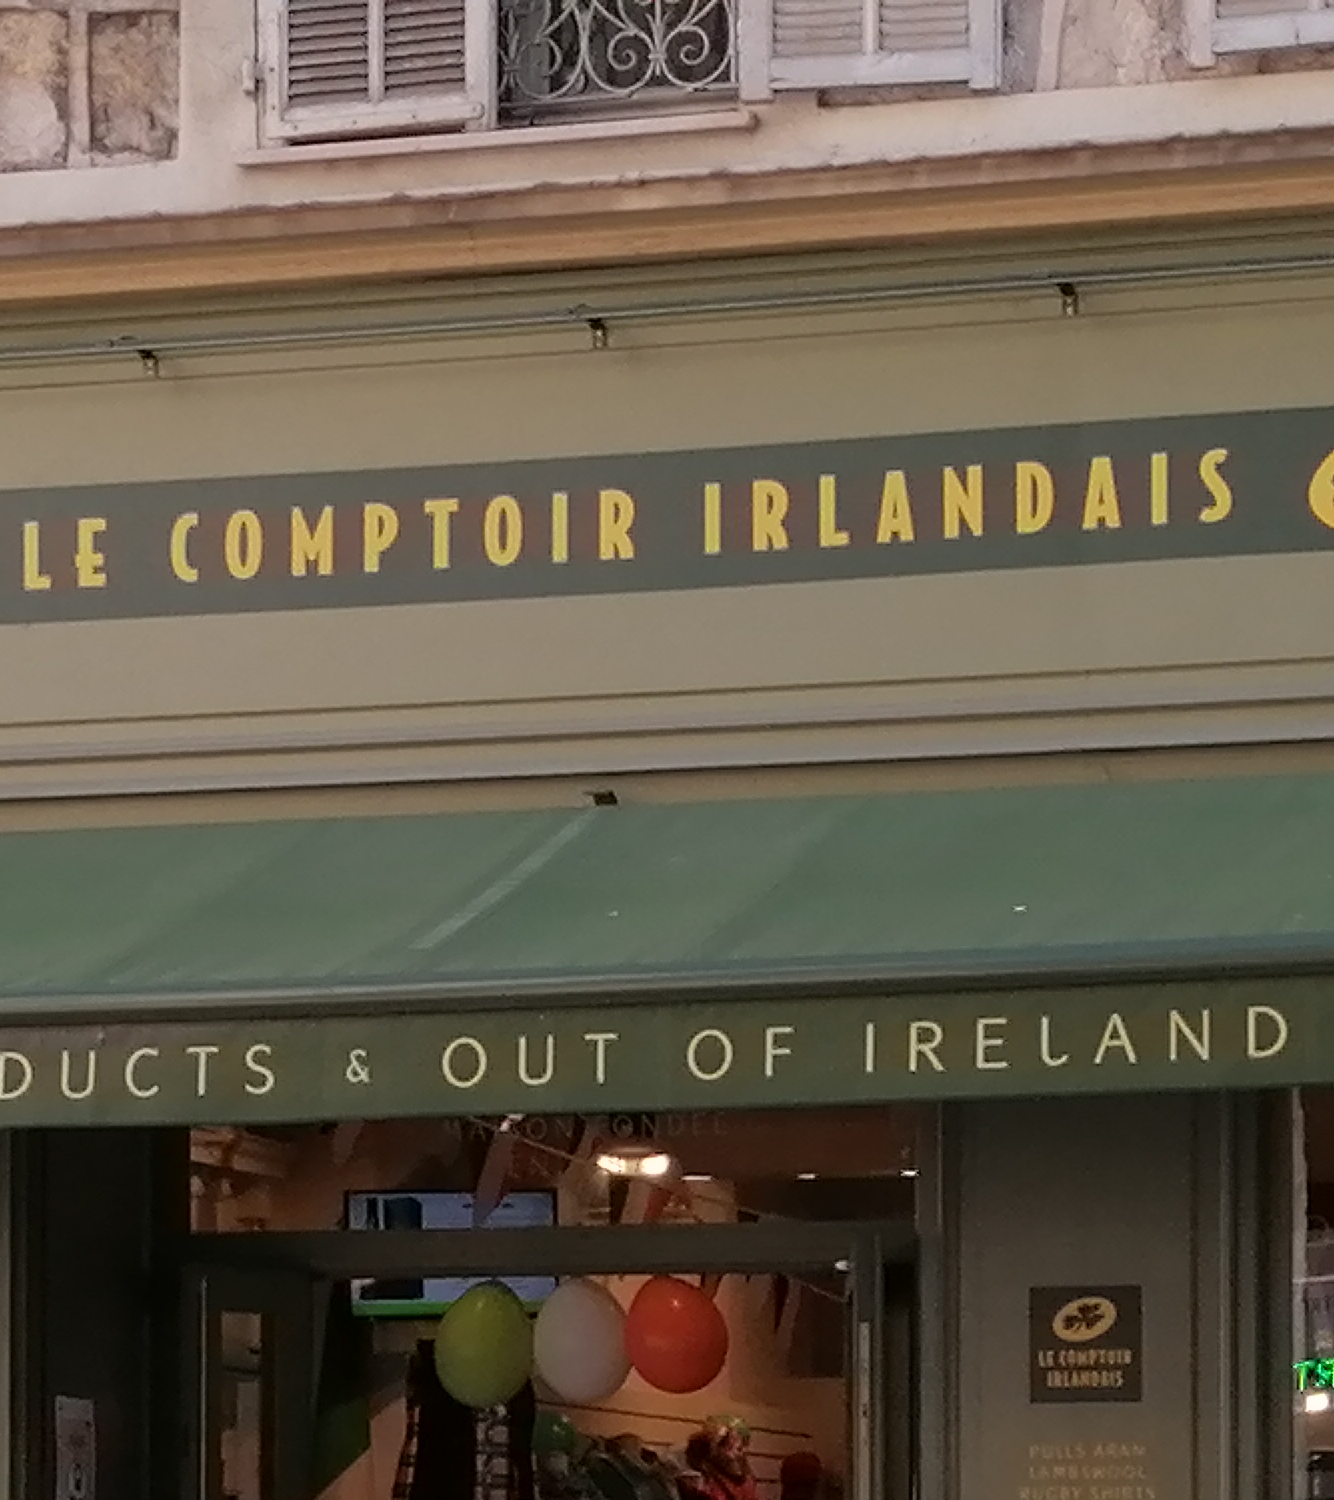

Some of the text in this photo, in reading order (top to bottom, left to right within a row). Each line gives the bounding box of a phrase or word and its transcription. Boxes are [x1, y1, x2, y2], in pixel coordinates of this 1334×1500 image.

[22, 448, 1234, 592] LE COMPTOIR IRLANDAIS
[345, 1048, 373, 1085] &
[441, 1032, 620, 1090] OUT
[686, 1025, 796, 1082] OF
[866, 1005, 1289, 1074] IRELAND
[1038, 1348, 1132, 1367] LE COMPTOIR
[1046, 1370, 1124, 1388] IRLANDAIS
[1028, 1443, 1087, 1460] PULLS
